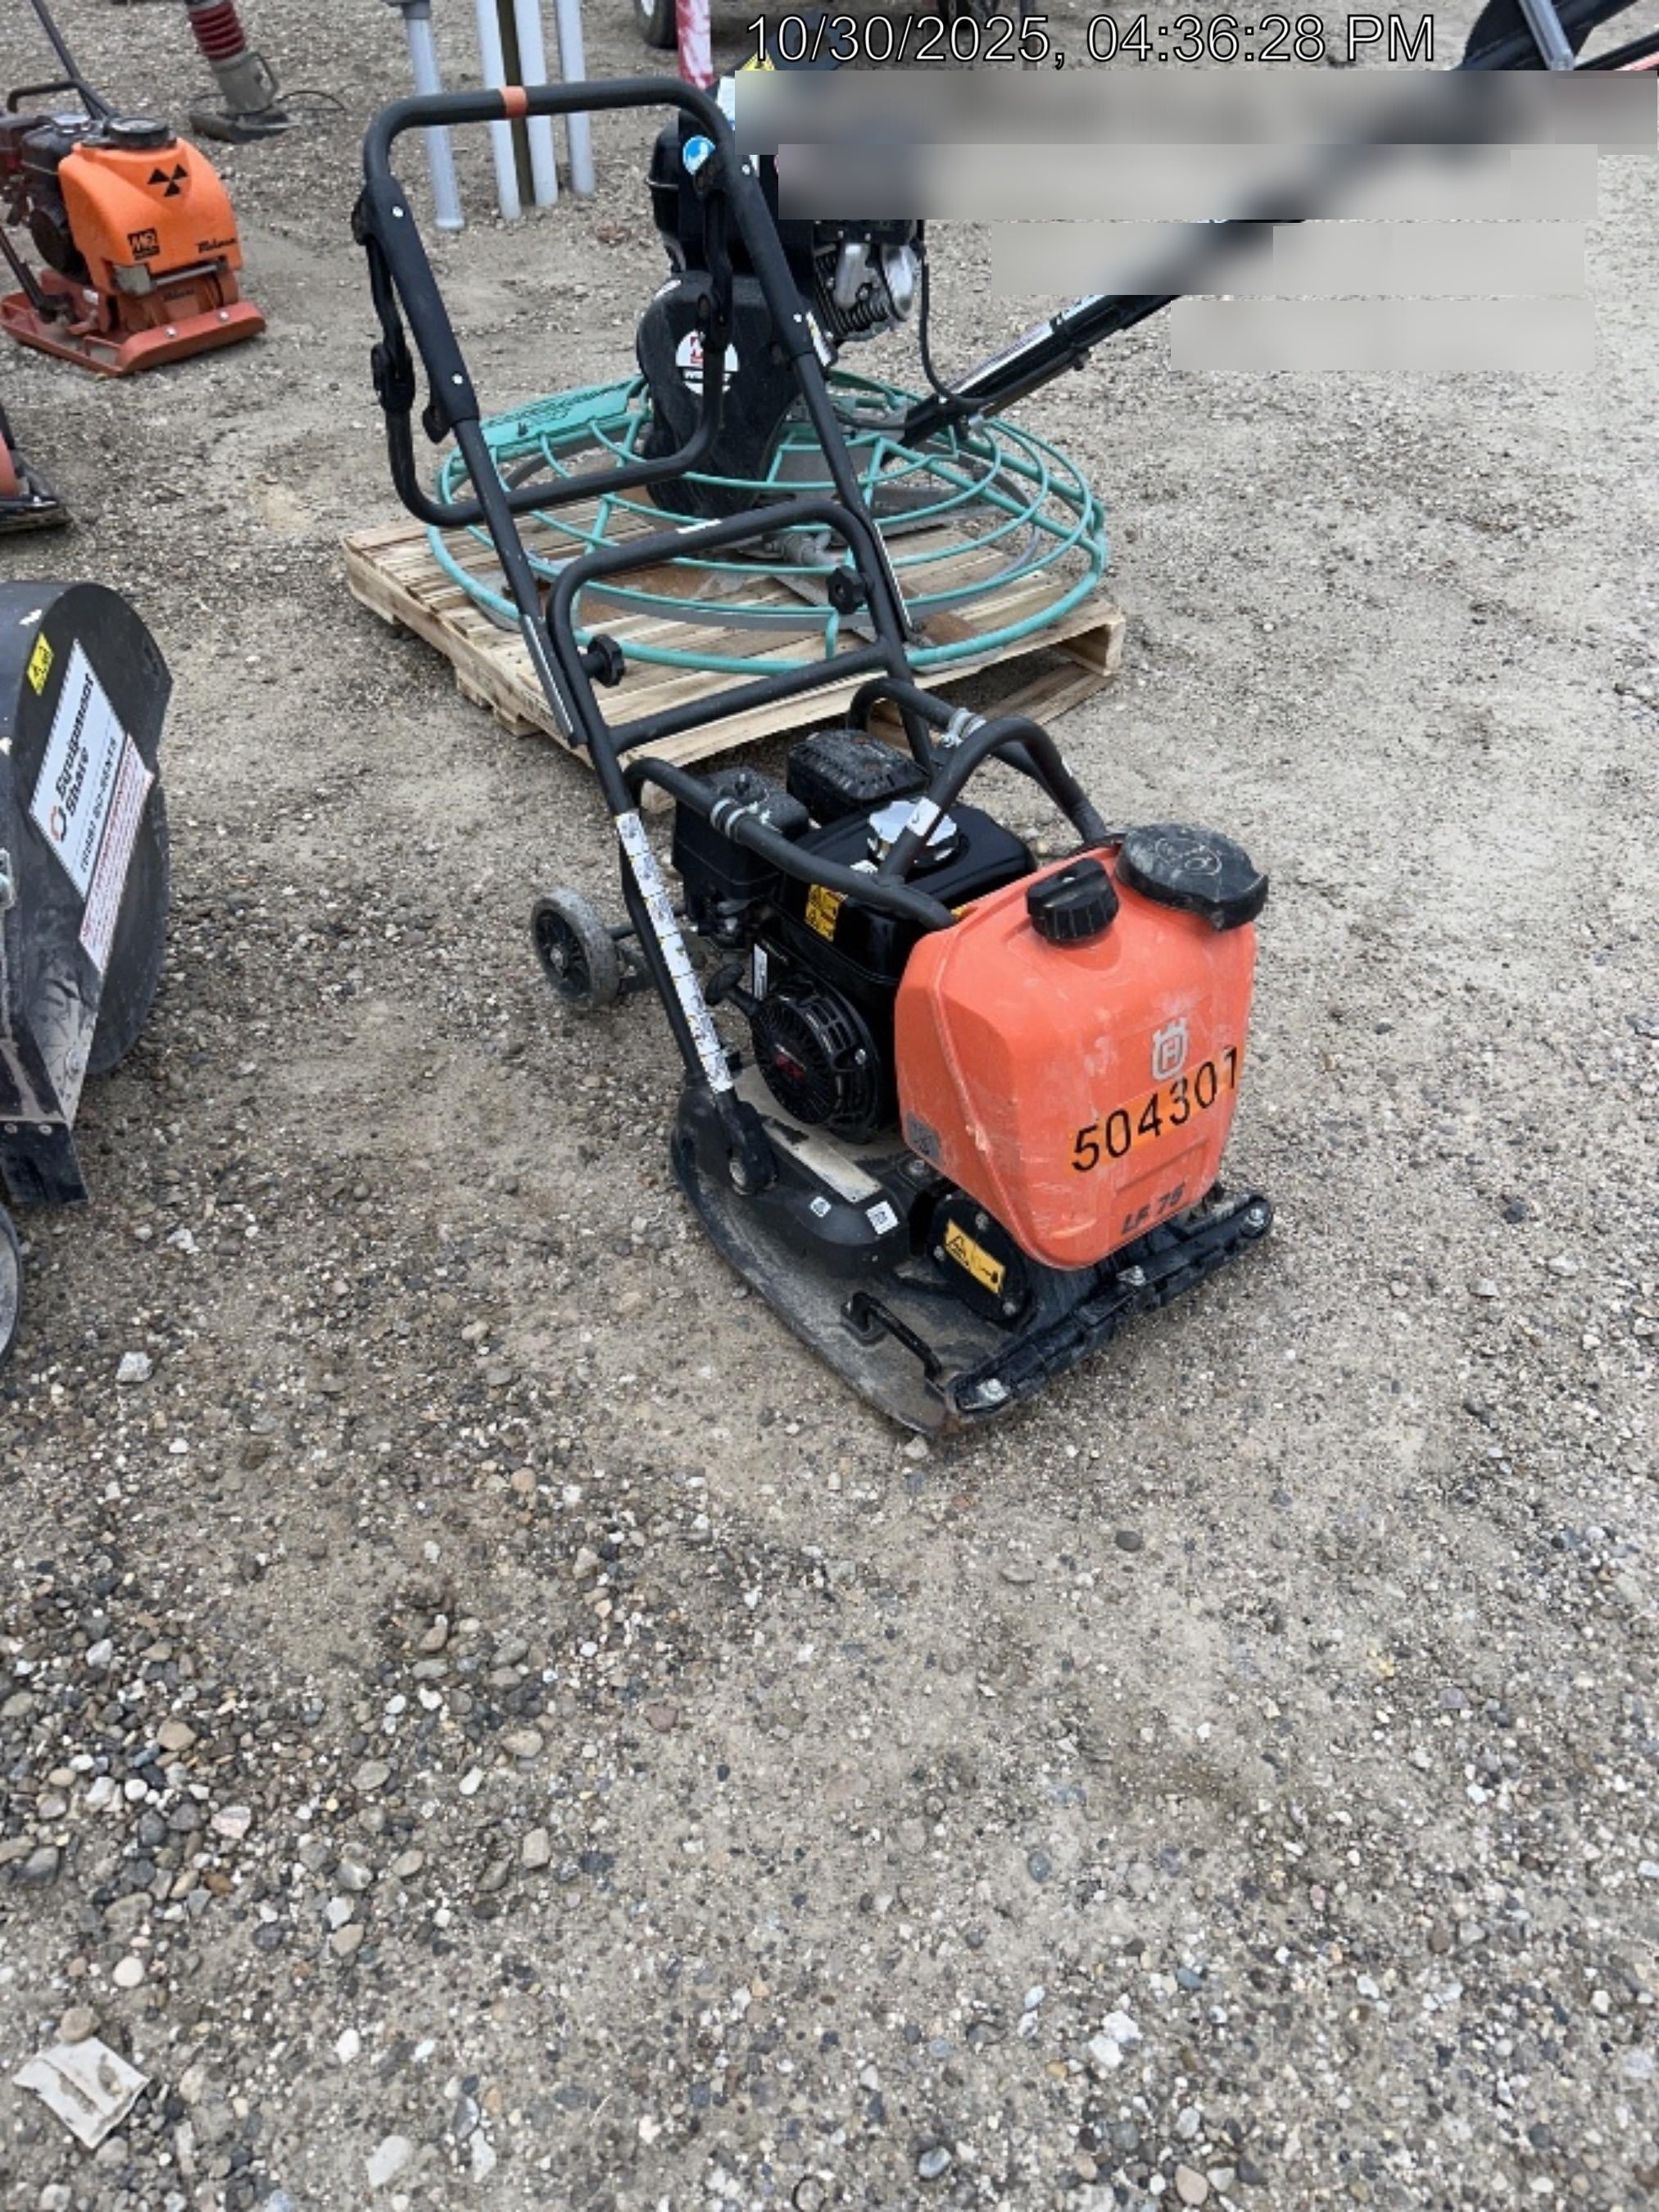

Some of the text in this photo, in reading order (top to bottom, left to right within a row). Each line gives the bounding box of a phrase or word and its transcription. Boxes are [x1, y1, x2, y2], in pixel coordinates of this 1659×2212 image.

[56, 672, 93, 800] Equipment
[66, 746, 88, 817] Share
[1071, 1045, 1238, 1172] 504301
